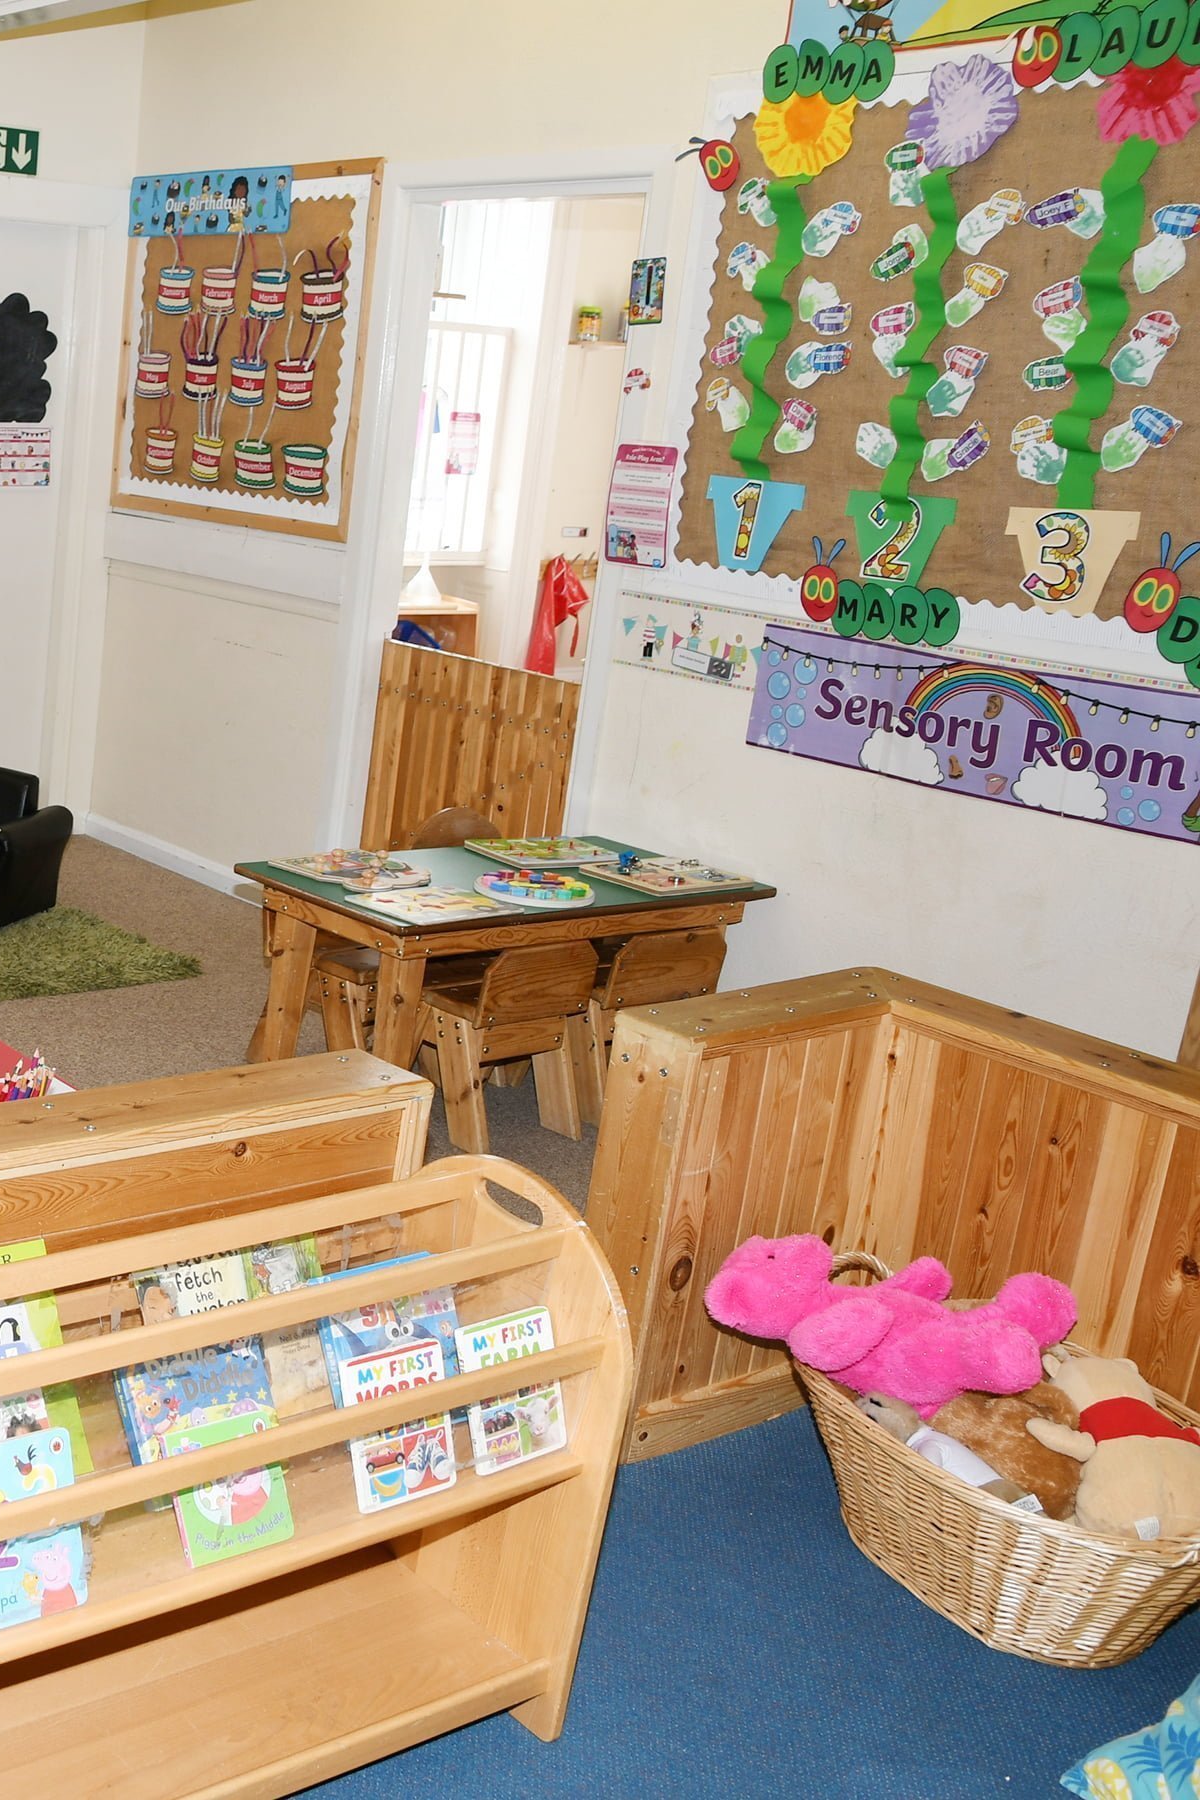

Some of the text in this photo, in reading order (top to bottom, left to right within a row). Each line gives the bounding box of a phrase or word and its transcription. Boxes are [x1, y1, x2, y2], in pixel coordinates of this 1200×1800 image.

[1065, 17, 1200, 62] LAU
[774, 54, 883, 89] EMMA
[165, 196, 247, 213] Our Birthdays
[1038, 204, 1062, 218] Joey
[162, 287, 186, 298] January
[205, 288, 232, 299] February
[258, 292, 279, 303] March
[313, 293, 333, 306] April
[145, 373, 159, 384] May
[194, 373, 208, 384] June
[1038, 367, 1059, 377] Bear
[241, 379, 255, 391] July
[284, 381, 308, 392] August
[147, 447, 173, 459] September
[955, 437, 979, 460] Gracie
[196, 454, 217, 466] October
[238, 460, 272, 472] November
[288, 465, 322, 478] December
[734, 482, 763, 558] 1
[863, 498, 921, 581] 2
[1023, 511, 1090, 602] 3
[837, 595, 950, 629] MARY
[814, 678, 1186, 791] Sensory Room
[174, 1267, 224, 1292] fetch
[195, 1291, 215, 1303] the
[473, 1317, 543, 1353] MY FIRST
[358, 1351, 434, 1386] MY FIRST
[255, 1511, 286, 1536] Middle
